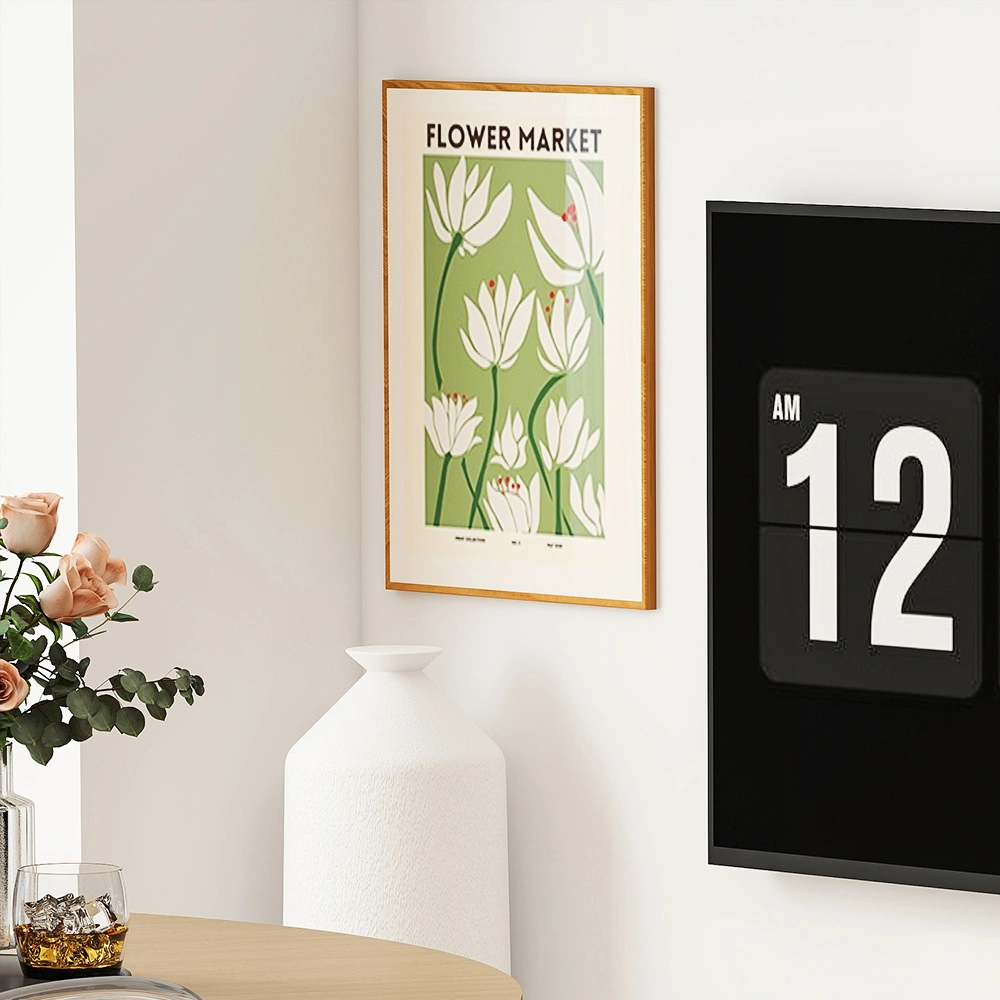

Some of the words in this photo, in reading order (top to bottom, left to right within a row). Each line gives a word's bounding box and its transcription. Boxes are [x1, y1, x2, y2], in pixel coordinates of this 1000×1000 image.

[427, 123, 511, 150] FLOWER
[519, 127, 602, 153] MARKET
[772, 393, 801, 421] AM
[787, 423, 953, 652] 12
